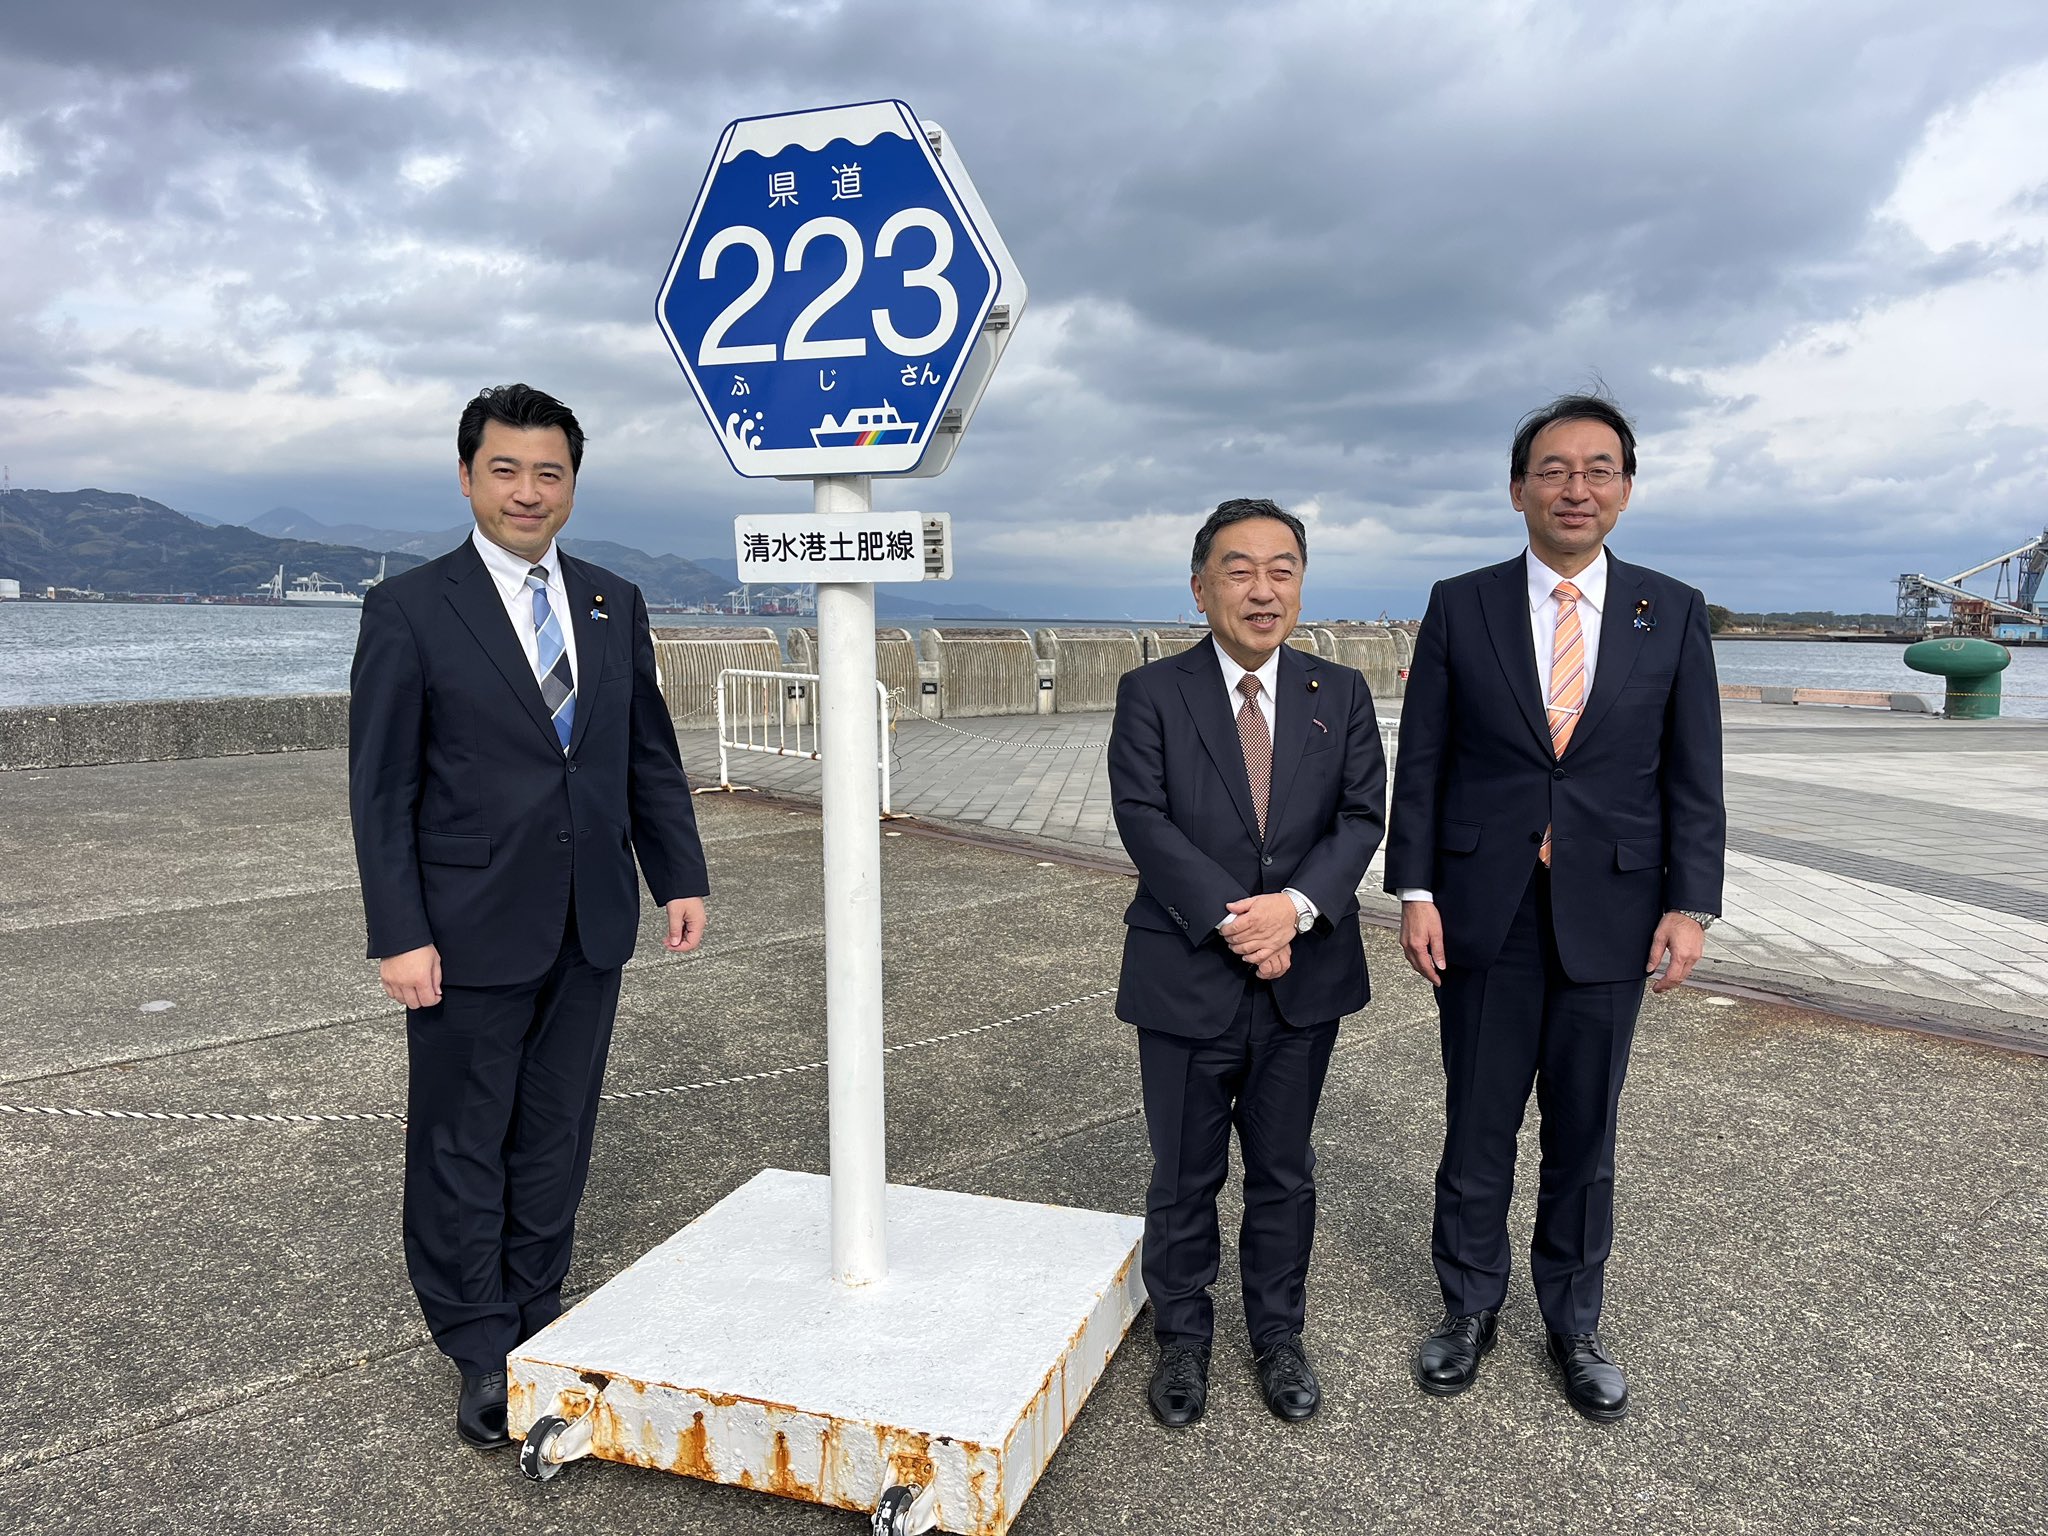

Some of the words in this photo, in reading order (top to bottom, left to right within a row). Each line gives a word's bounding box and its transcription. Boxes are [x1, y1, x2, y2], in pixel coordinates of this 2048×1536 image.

[768, 162, 863, 208] 県道
[697, 207, 959, 367] 223
[743, 529, 915, 563] 清水港土肥線
